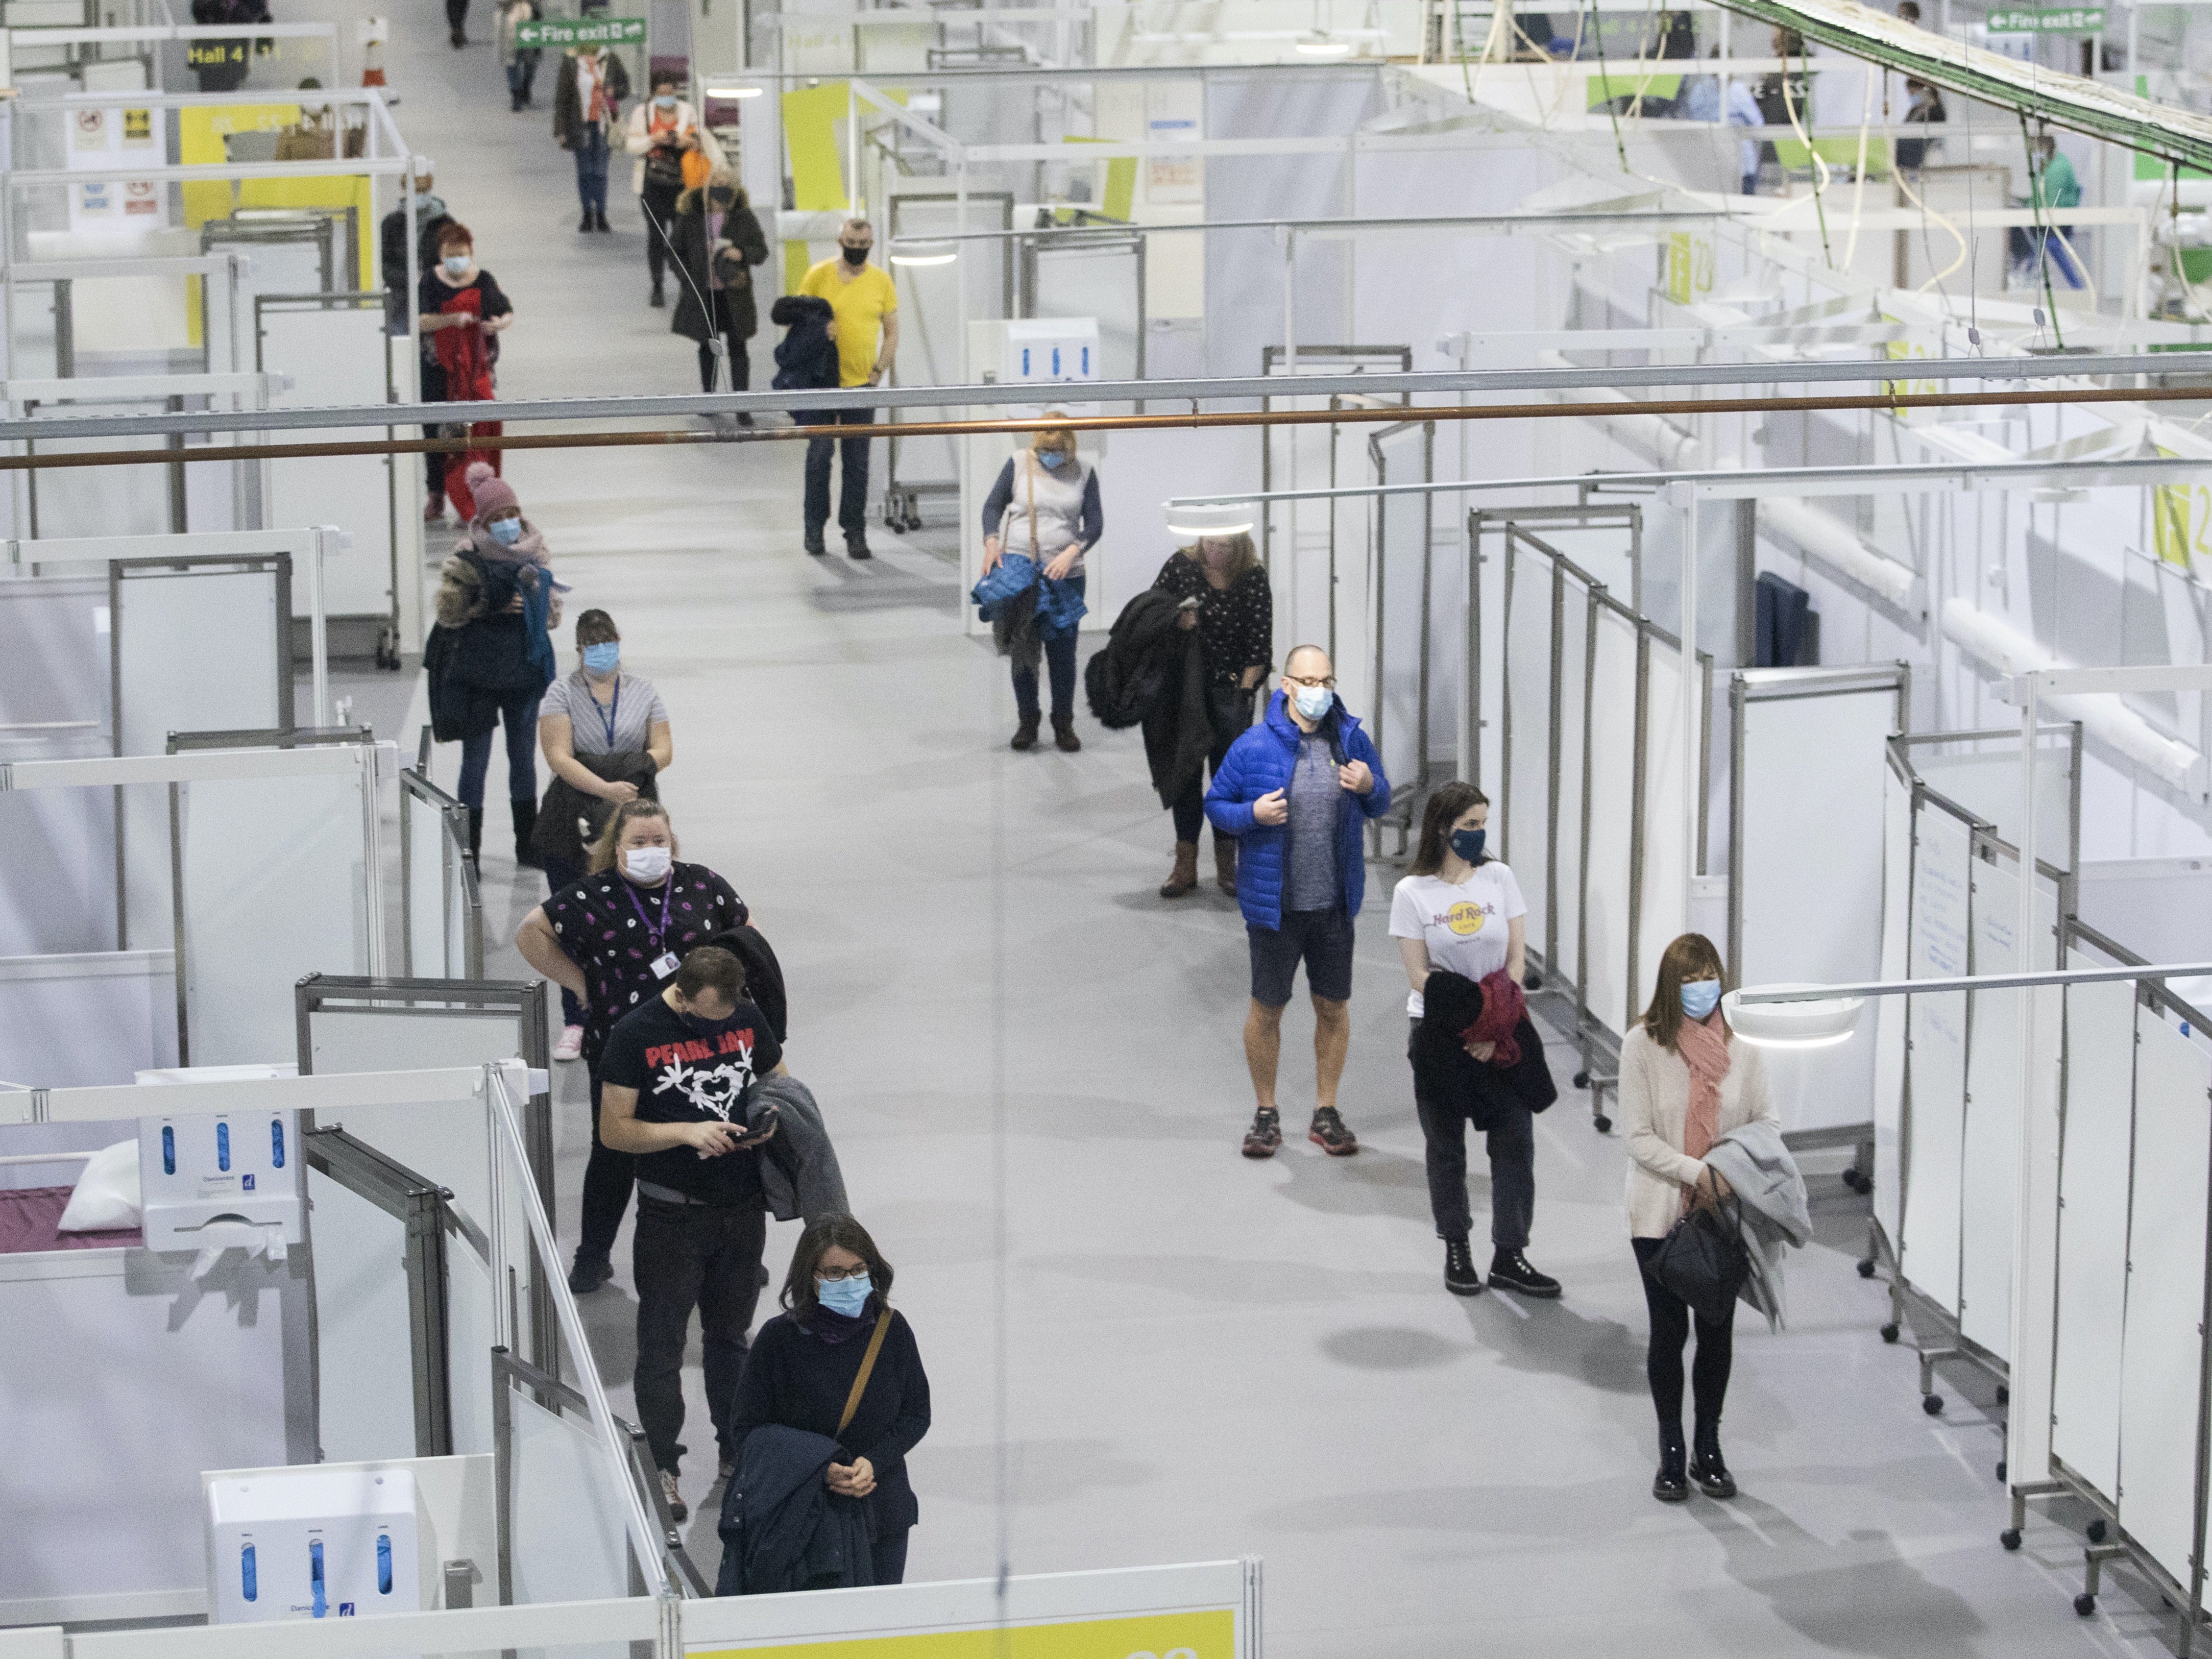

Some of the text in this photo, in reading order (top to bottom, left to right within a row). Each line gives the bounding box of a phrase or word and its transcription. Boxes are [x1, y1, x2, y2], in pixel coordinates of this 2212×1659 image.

[540, 24, 609, 41] Fire exit
[188, 45, 225, 64] Hall
[231, 45, 243, 63] 4
[1433, 902, 1496, 926] Hard Rock
[645, 1027, 755, 1068] PEARL JAM
